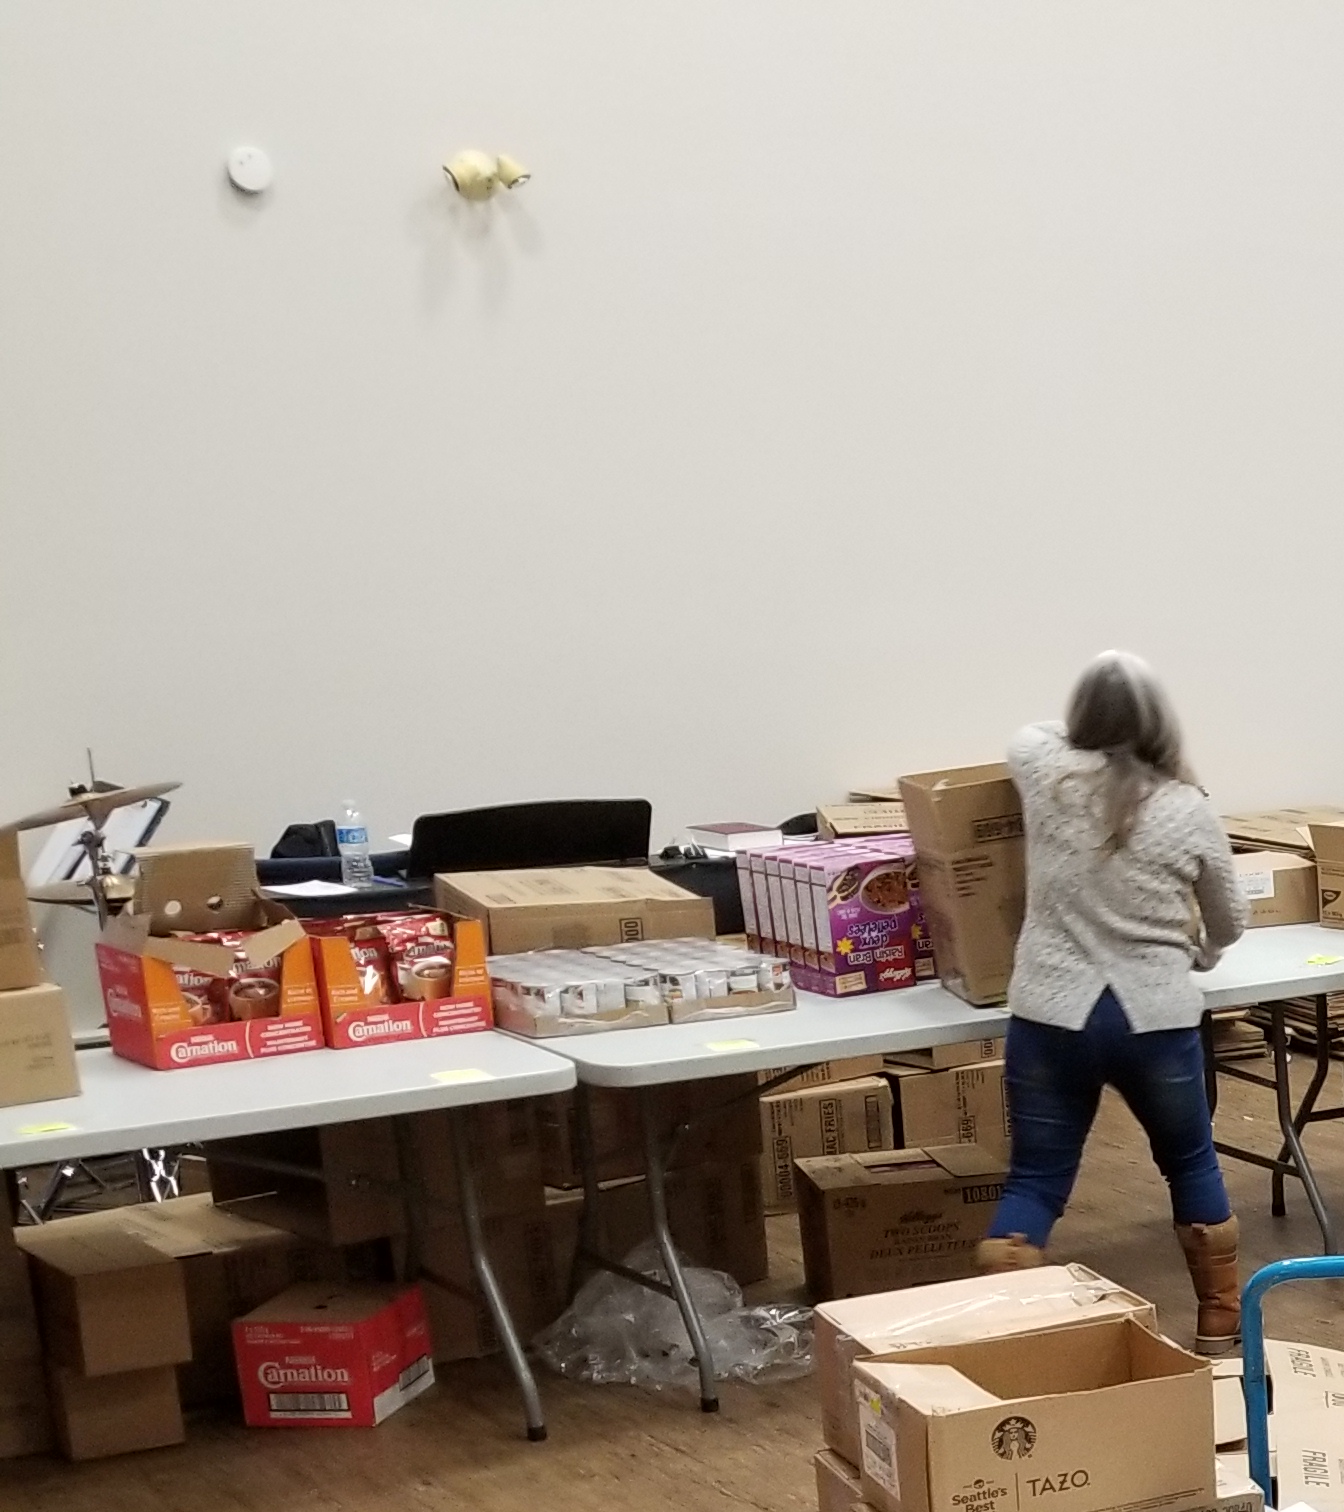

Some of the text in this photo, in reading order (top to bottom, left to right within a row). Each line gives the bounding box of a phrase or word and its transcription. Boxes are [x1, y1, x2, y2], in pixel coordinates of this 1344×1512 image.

[861, 935, 889, 948] deux
[847, 952, 873, 965] Bran
[348, 1019, 412, 1042] Carnation
[170, 1039, 238, 1064] Carnation
[821, 1101, 837, 1136] FRIES
[884, 1223, 960, 1239] TWO SCOOPS
[258, 1361, 349, 1388] Carnation
[1288, 1347, 1317, 1378] FRAGILE
[1301, 1449, 1331, 1488] FRAGILE
[1026, 1468, 1090, 1498] TAZO
[951, 1486, 1008, 1506] Seattle's
